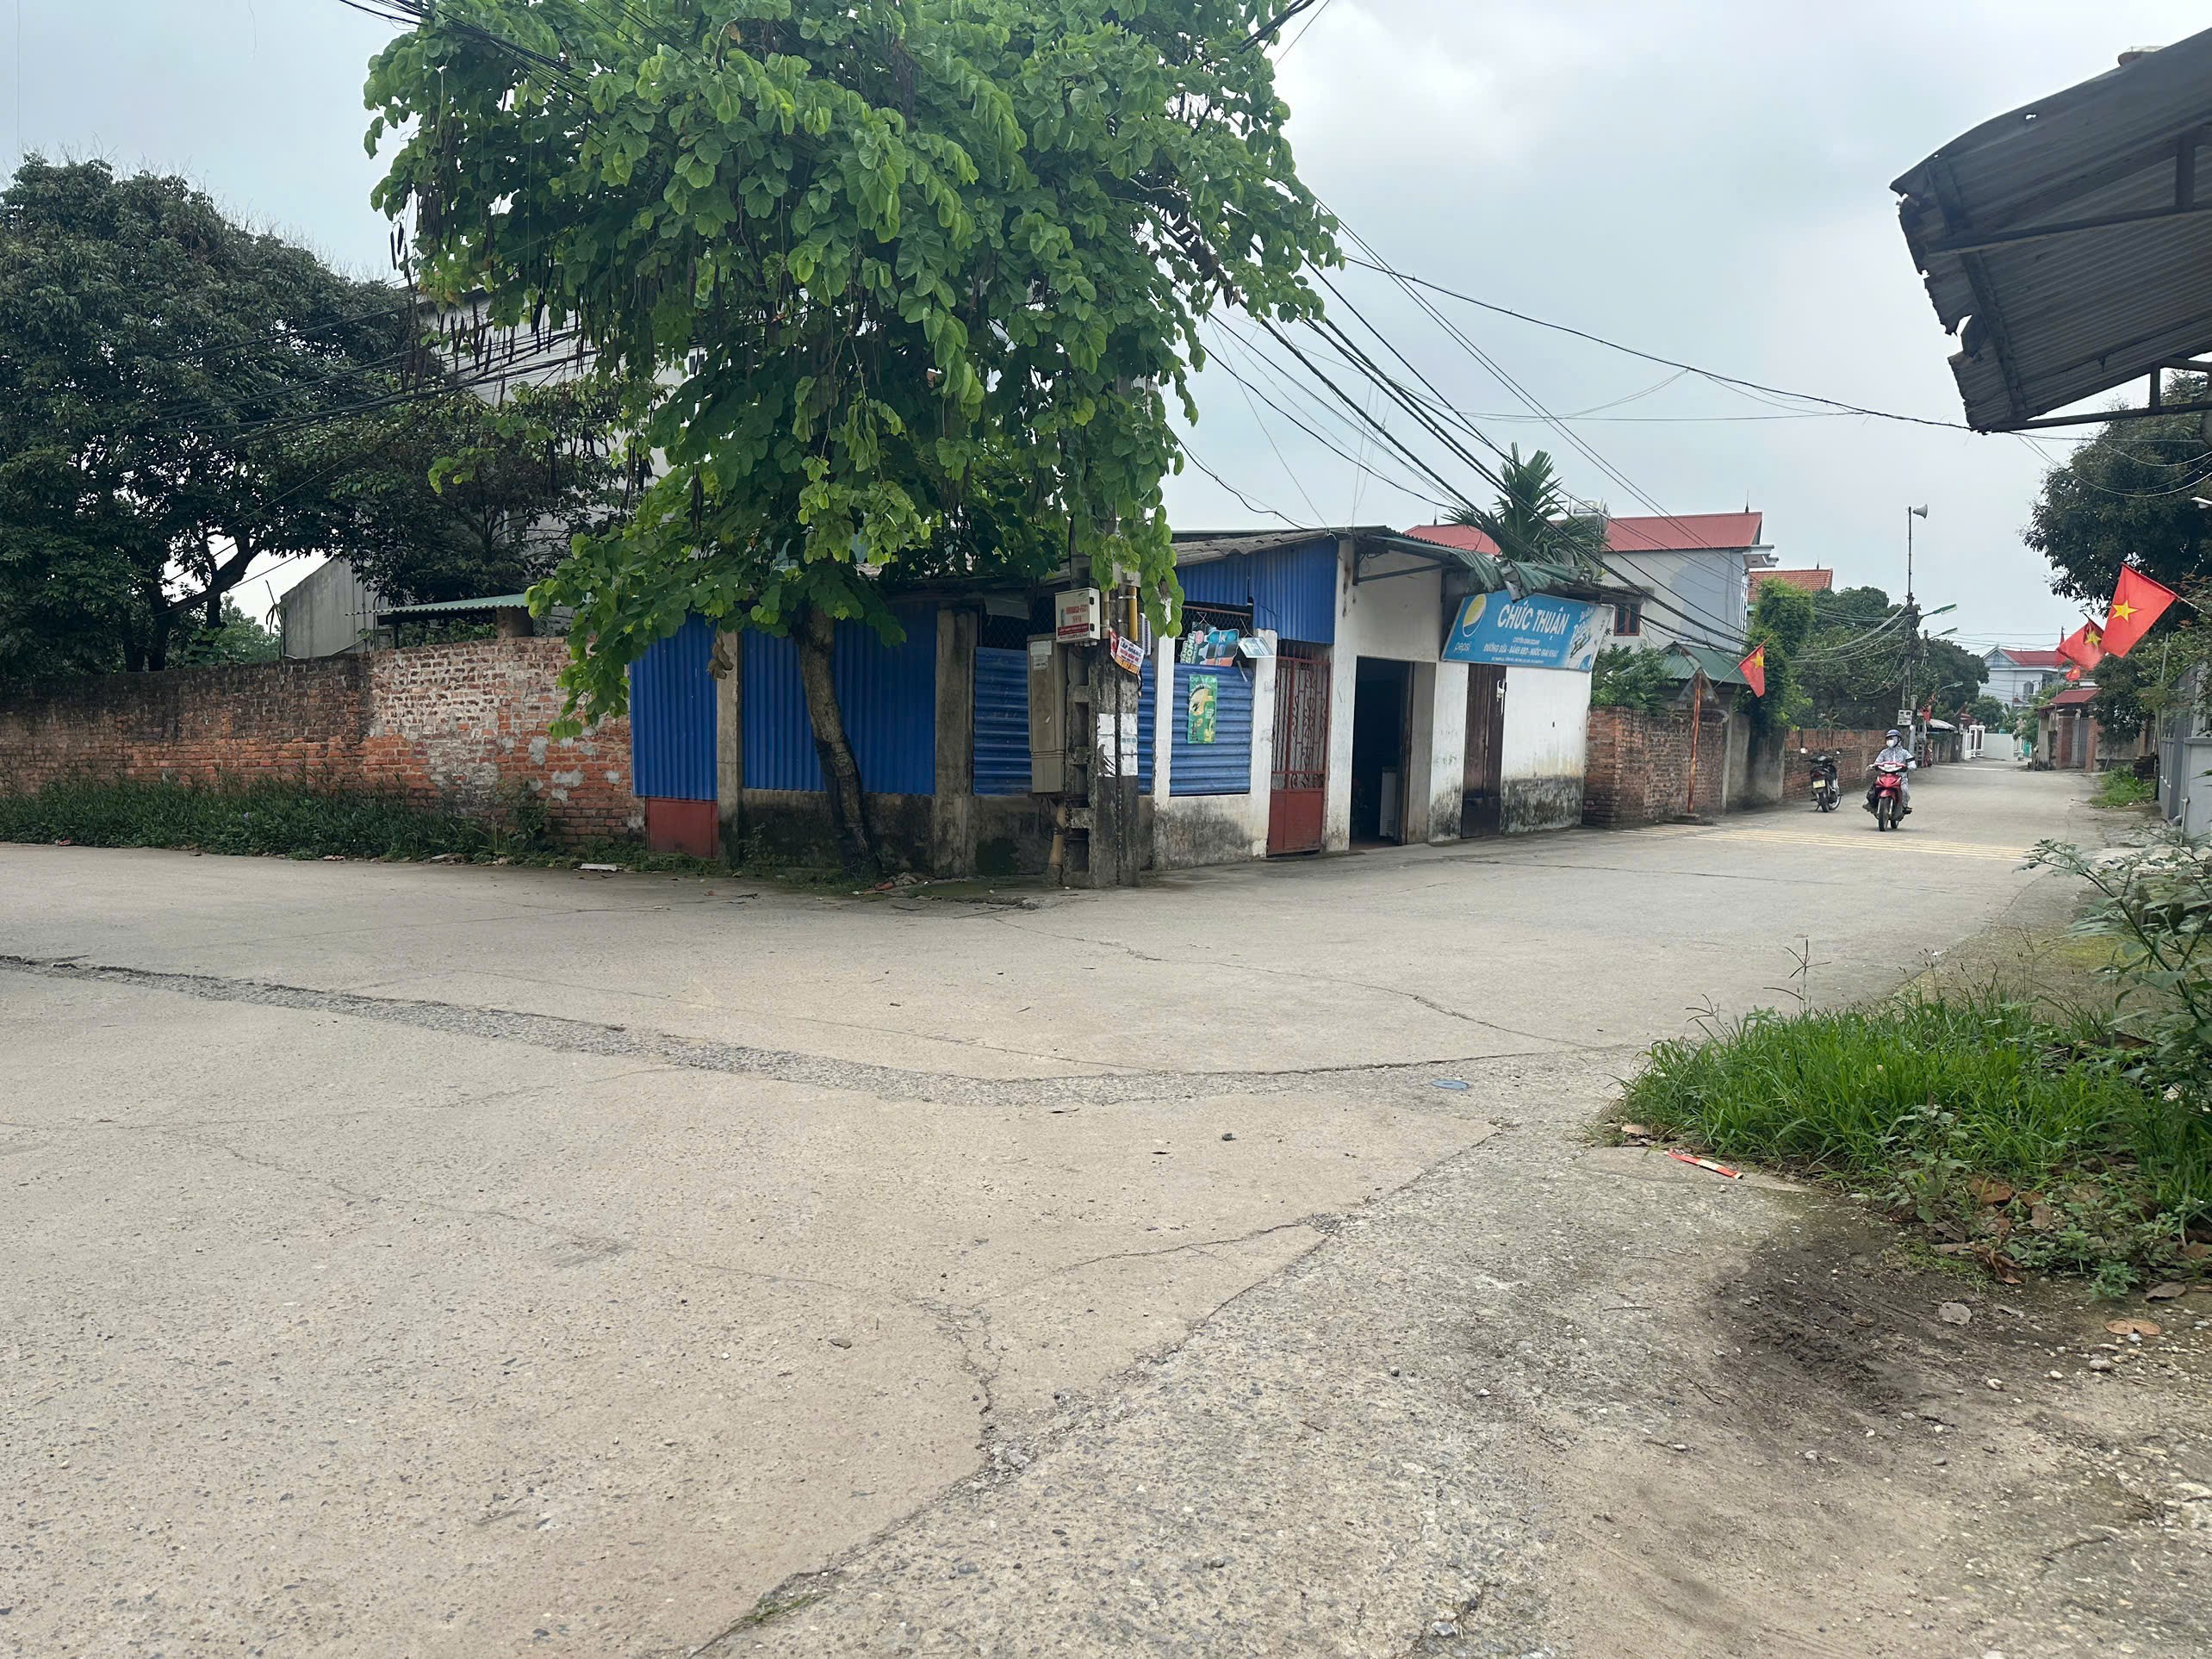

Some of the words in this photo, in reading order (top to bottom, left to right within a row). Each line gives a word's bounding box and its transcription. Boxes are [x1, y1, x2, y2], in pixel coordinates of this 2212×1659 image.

[1497, 600, 1533, 631] CHỨC
[1532, 606, 1570, 641] THUẬN
[1455, 641, 1470, 653] pepsi
